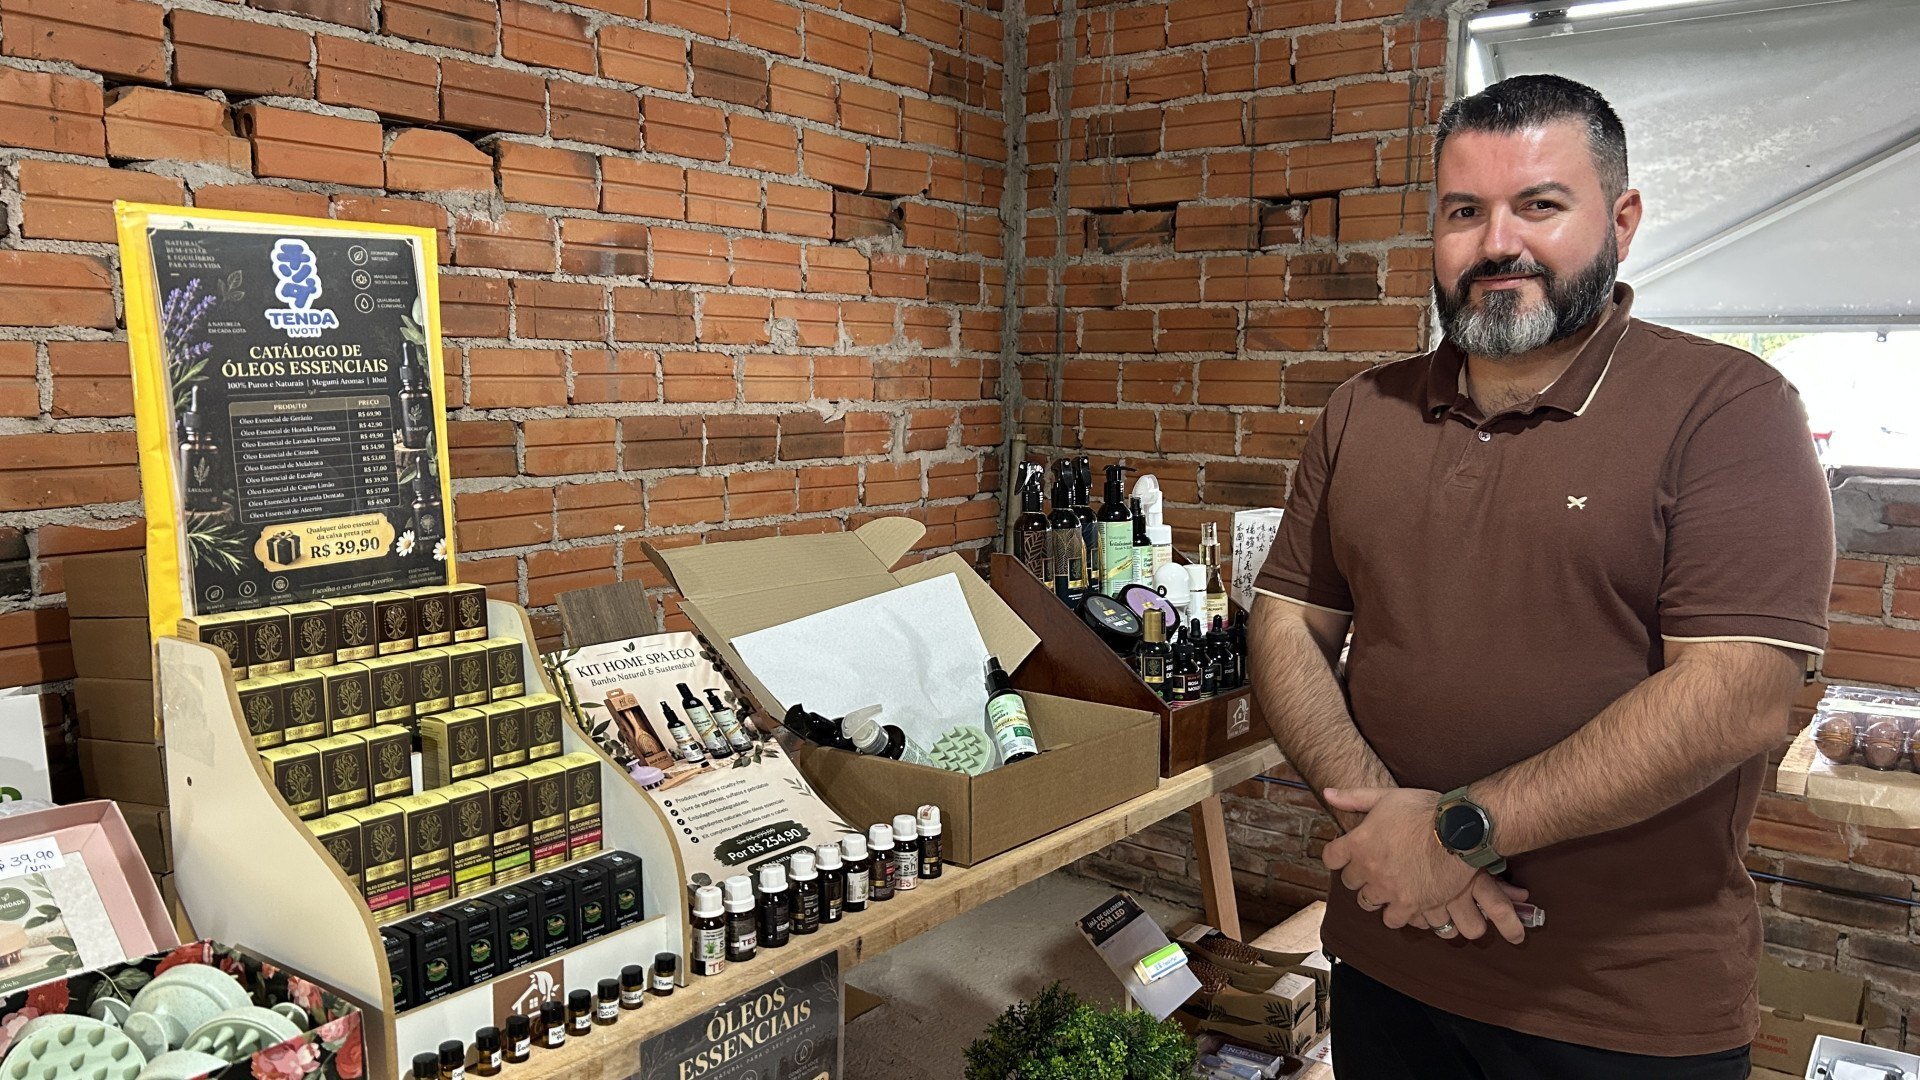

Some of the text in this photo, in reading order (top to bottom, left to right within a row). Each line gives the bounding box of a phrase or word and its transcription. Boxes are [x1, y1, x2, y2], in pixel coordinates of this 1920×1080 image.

[269, 312, 335, 325] TENDA
[249, 343, 362, 359] CATÁLOGO DE
[222, 359, 388, 377] ÓLEOS ESSENCIAIS
[275, 380, 304, 388] Naturais
[312, 379, 339, 387] Megumi
[340, 377, 364, 385] Aromas
[306, 526, 337, 534] Qualquer
[352, 519, 380, 528] essencial
[344, 531, 359, 539] preta
[310, 537, 380, 558] R$ 39,90
[312, 586, 335, 594] Escolha
[371, 577, 393, 586] favorito
[576, 648, 695, 677] KIT HOME SPA ECO
[591, 676, 616, 686] Banho
[618, 668, 647, 681] Natural
[655, 660, 696, 673] Sustentável
[675, 779, 746, 803] Produtos veganos cruelty-free
[726, 790, 744, 799] sulfatos
[747, 782, 769, 793] petrolatos
[688, 800, 749, 821] Embalagens biodegradáveis
[695, 819, 723, 831] Ingredientes
[724, 812, 741, 821] naturais
[764, 799, 785, 808] essenciais
[710, 827, 731, 838] completo
[732, 823, 742, 831] para
[742, 817, 761, 826] cuidados
[775, 807, 788, 815] cabelo
[728, 850, 748, 860] Por
[747, 843, 764, 854] R$
[762, 828, 801, 847] 254,90
[10, 850, 55, 868] 39,90
[0, 900, 26, 911] OVIDADE
[1088, 900, 1126, 928] ÍMÃ DE GELADEIRA
[1096, 908, 1125, 931] COM LED
[706, 986, 786, 1042] ÓLEOS
[678, 999, 811, 1080] ESSENCIAIS
